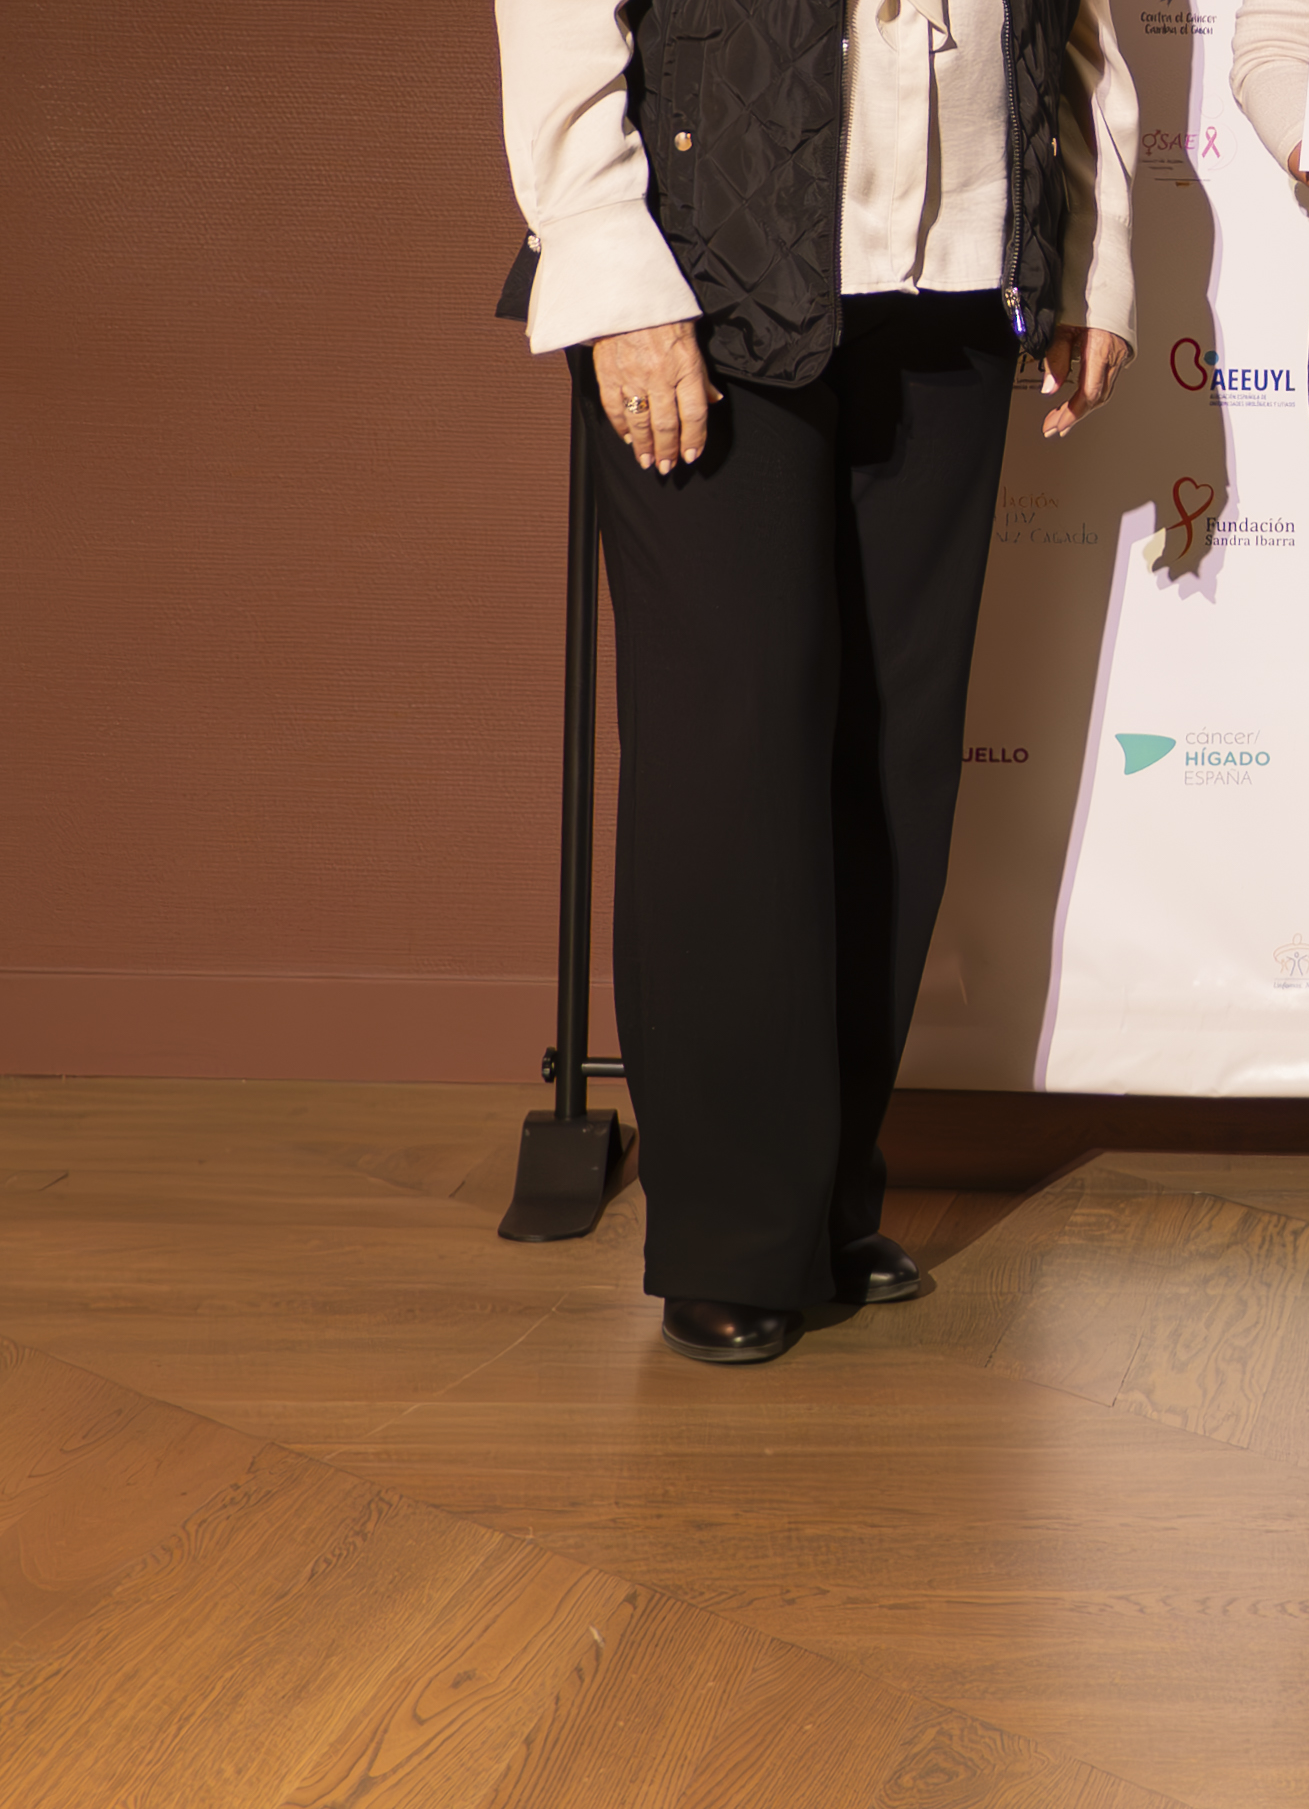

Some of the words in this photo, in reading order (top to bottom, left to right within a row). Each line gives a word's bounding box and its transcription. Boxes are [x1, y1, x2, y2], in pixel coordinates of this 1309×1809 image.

[1210, 368, 1296, 391] AEEUYL
[1206, 517, 1296, 533] Fundación
[1204, 533, 1251, 547] Sandra
[1255, 534, 1296, 547] Ibarra
[961, 747, 1029, 766] UELLO
[1184, 746, 1271, 768] HÍGADO
[1183, 768, 1253, 787] ESPAÑA
